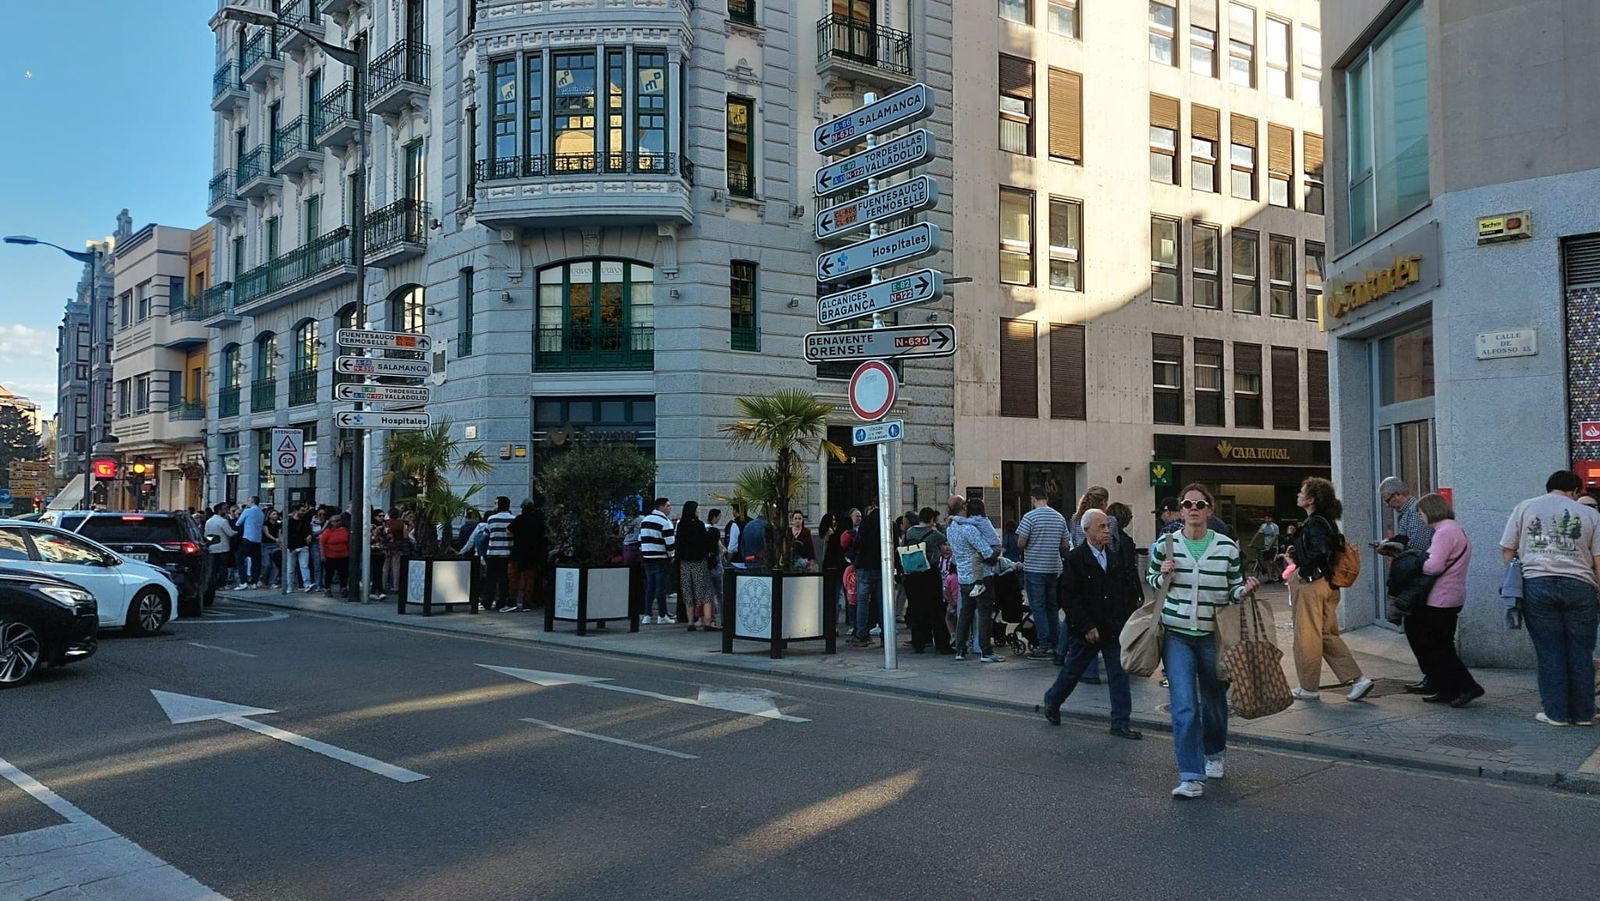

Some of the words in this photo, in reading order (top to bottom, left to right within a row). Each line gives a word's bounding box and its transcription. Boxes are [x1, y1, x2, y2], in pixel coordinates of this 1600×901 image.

[858, 94, 921, 127] SALAMANCA
[865, 135, 922, 162] TORDESILLAS
[865, 145, 923, 173] VALLADOLID
[858, 181, 924, 211] FUENTESAUCO
[866, 192, 925, 218] FERMOSELLE
[872, 234, 927, 258] Hospitales
[821, 290, 868, 310] ALCAÑICES
[821, 299, 876, 320] BRAGANÇA
[341, 331, 395, 340] FUENTESAUCO
[341, 338, 388, 346] FERMOSELLE
[809, 335, 874, 346] BENAVENTE
[1495, 333, 1520, 341] CALLE
[810, 345, 865, 357] ORENSE
[1481, 347, 1518, 355] ALFONSO
[377, 363, 428, 372] SALAMANCA
[381, 417, 427, 426] Hospitales
[1232, 447, 1257, 459] CAJA
[1256, 447, 1290, 460] RURAL
